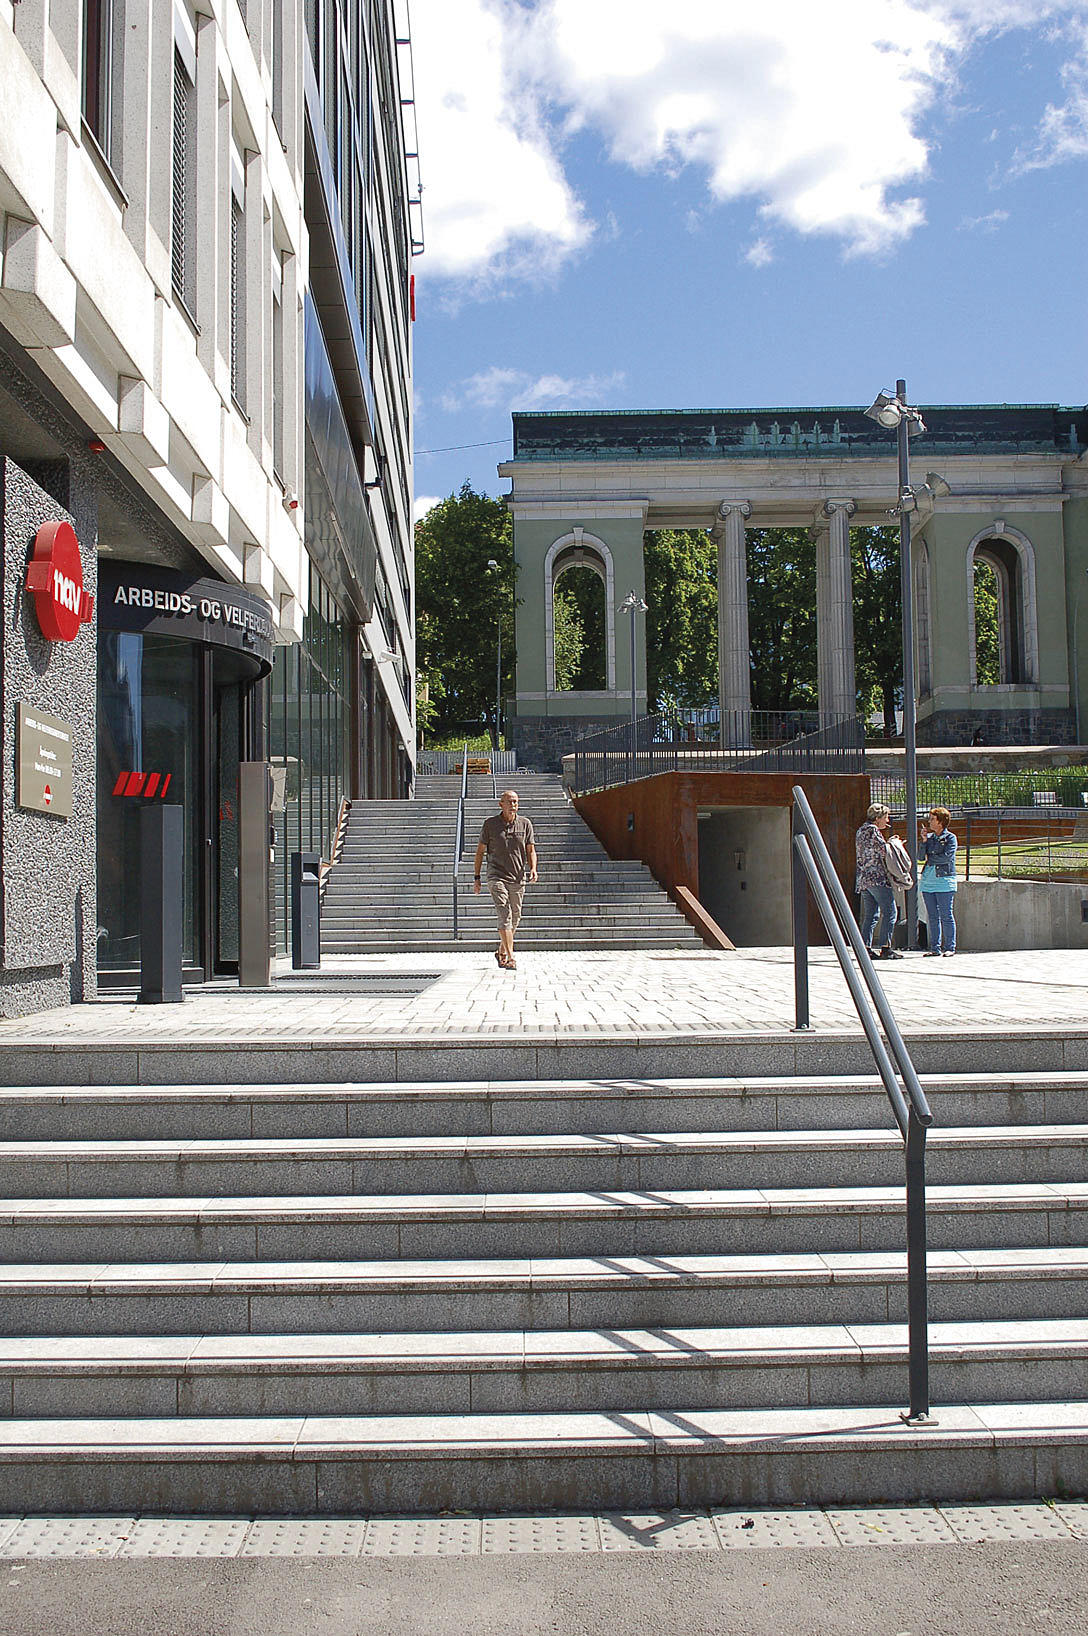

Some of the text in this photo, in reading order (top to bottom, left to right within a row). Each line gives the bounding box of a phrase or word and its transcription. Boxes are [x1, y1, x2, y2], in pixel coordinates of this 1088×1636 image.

[54, 568, 82, 616] nav
[114, 585, 197, 614] ARBEIDS-
[200, 598, 221, 620] OG
